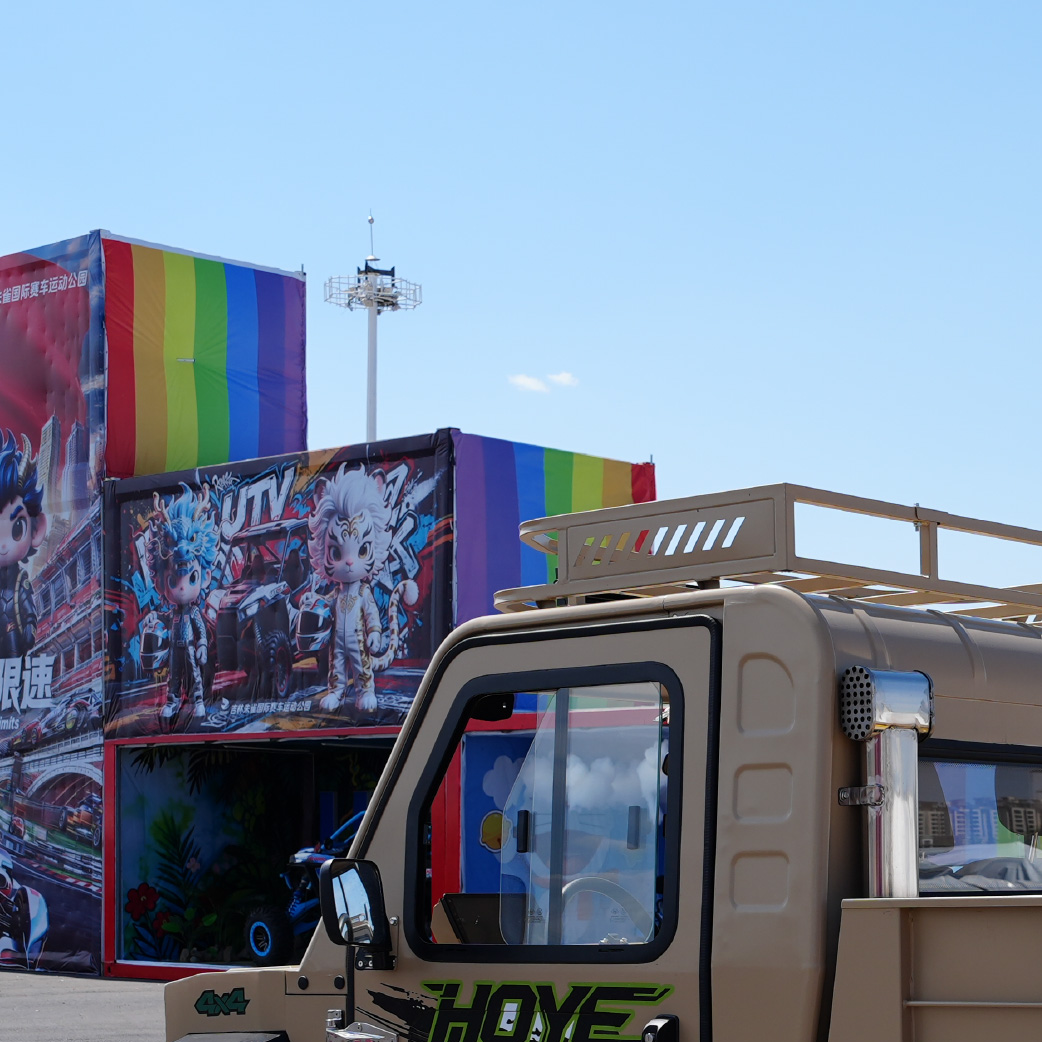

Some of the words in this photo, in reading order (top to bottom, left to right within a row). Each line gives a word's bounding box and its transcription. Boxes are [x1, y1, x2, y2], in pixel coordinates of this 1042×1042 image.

[221, 467, 295, 540] UTV
[230, 701, 312, 715] 吉林朱雀国际赛车运动公园
